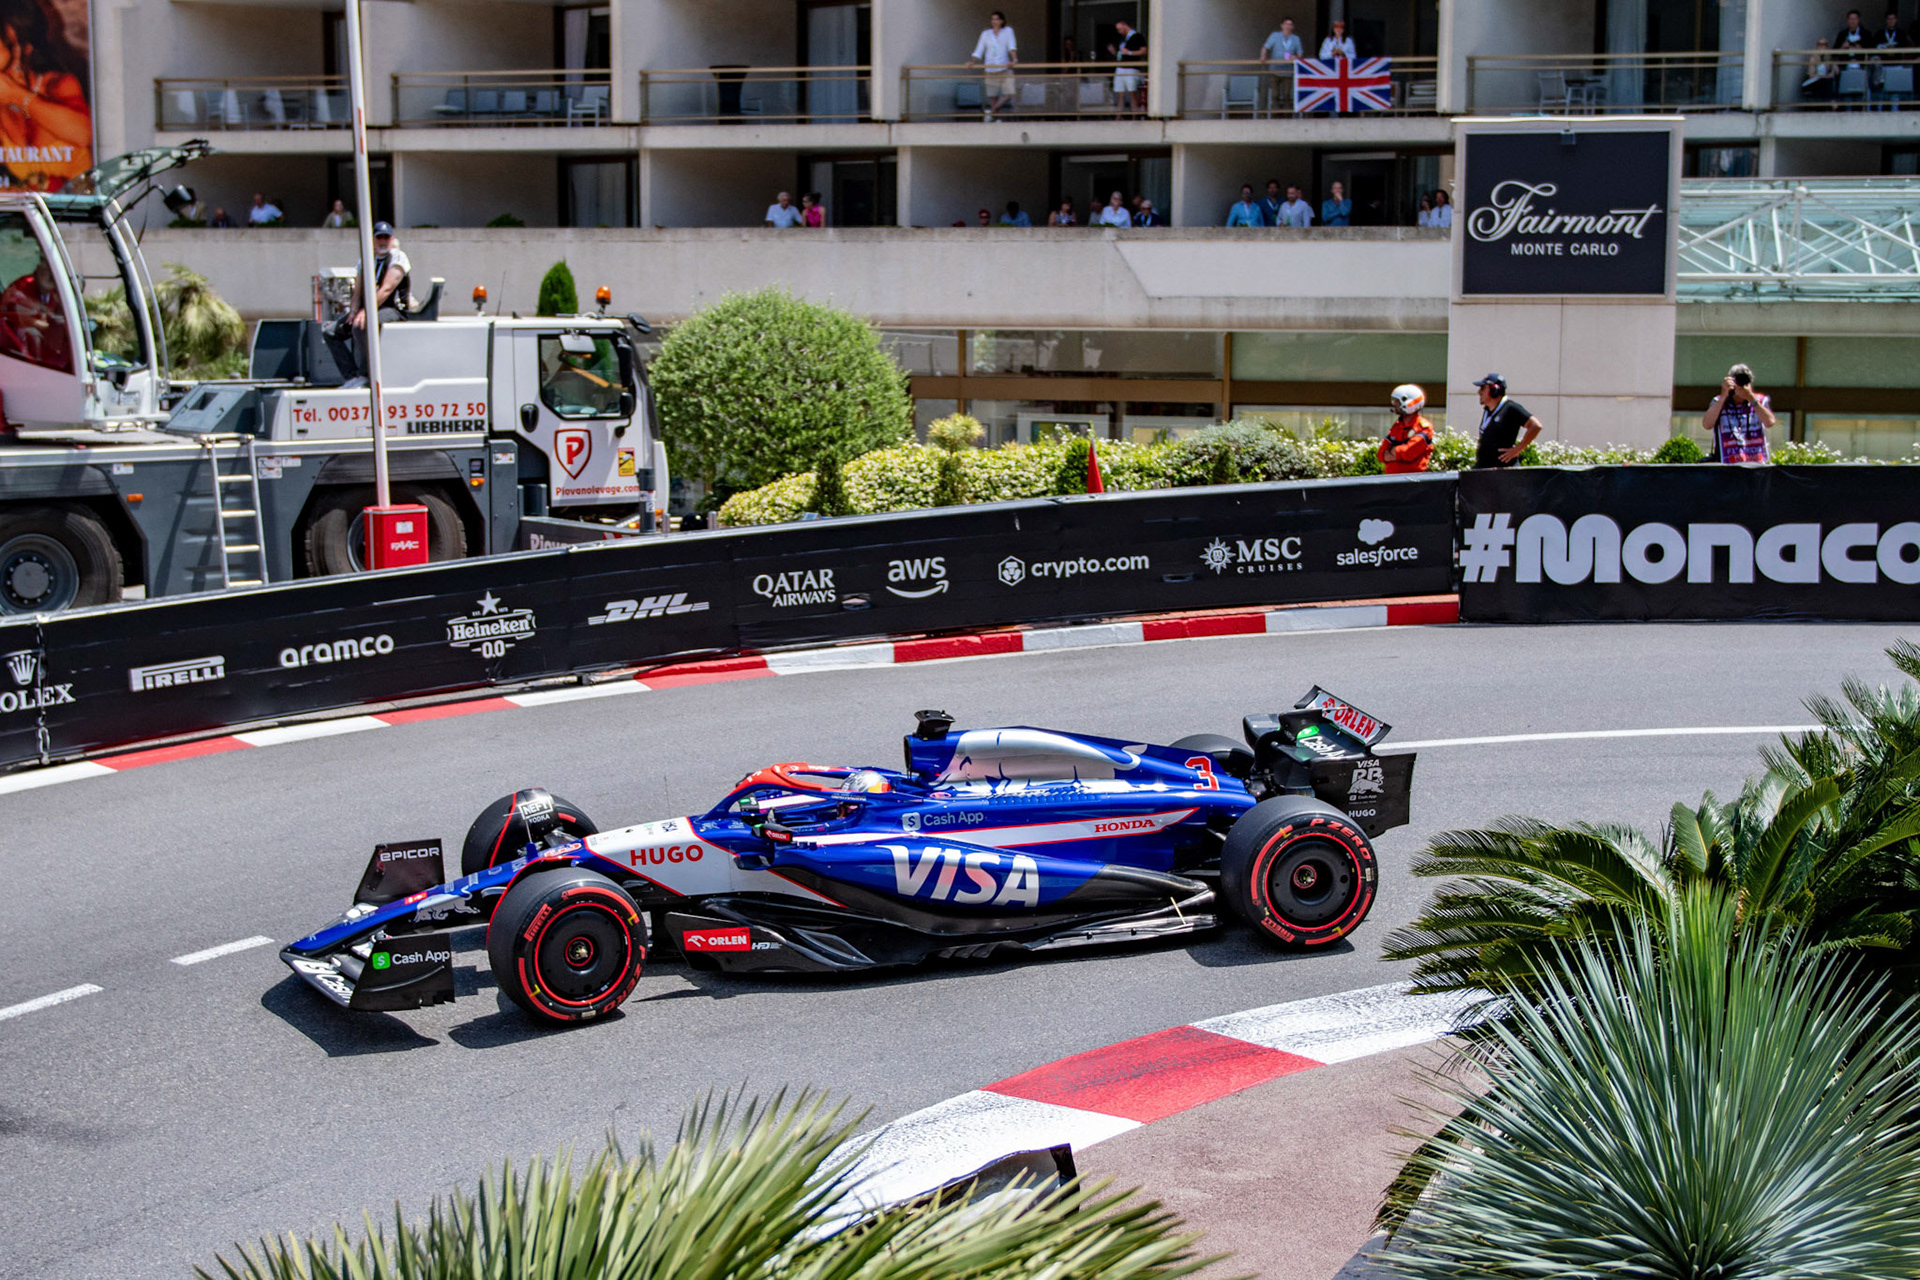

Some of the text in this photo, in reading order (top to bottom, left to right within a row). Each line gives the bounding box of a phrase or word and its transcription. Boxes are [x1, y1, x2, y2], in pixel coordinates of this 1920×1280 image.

[1468, 180, 1663, 242] Fairmont
[1511, 243, 1619, 256] MONTE CARLO
[293, 402, 486, 423] Tél. 0037 93 50 72 50
[407, 419, 486, 434] LIEBHERR
[390, 540, 420, 551] FAAC
[1235, 536, 1302, 563] MSC
[1336, 546, 1418, 567] salesforce
[1459, 513, 1920, 585] #Monaco
[887, 556, 947, 582] aws
[1031, 555, 1150, 578] crypto.com
[1236, 562, 1303, 574] CRUISES
[752, 568, 835, 598] QATAR
[587, 592, 710, 625] DHL
[772, 589, 836, 608] AIRWAYS
[452, 618, 531, 641] Heineken
[279, 634, 395, 669] aramco
[481, 639, 506, 659] 0.0
[129, 654, 226, 693] PIRELLI
[0, 682, 77, 714] OLEX
[1333, 703, 1376, 739] ORLEN
[1185, 756, 1220, 791] 3
[1356, 759, 1380, 768] VISA
[522, 802, 549, 815] NEFT
[923, 812, 956, 826] Cash
[957, 811, 984, 825] App
[1348, 809, 1377, 817] HUGO
[1094, 818, 1156, 833] HONDA
[1309, 818, 1372, 860] P ZERO
[630, 844, 704, 866] HUGO
[882, 845, 1041, 907] VISA
[708, 935, 747, 946] ORLEN
[392, 953, 423, 965] Cash
[425, 950, 450, 964] App
